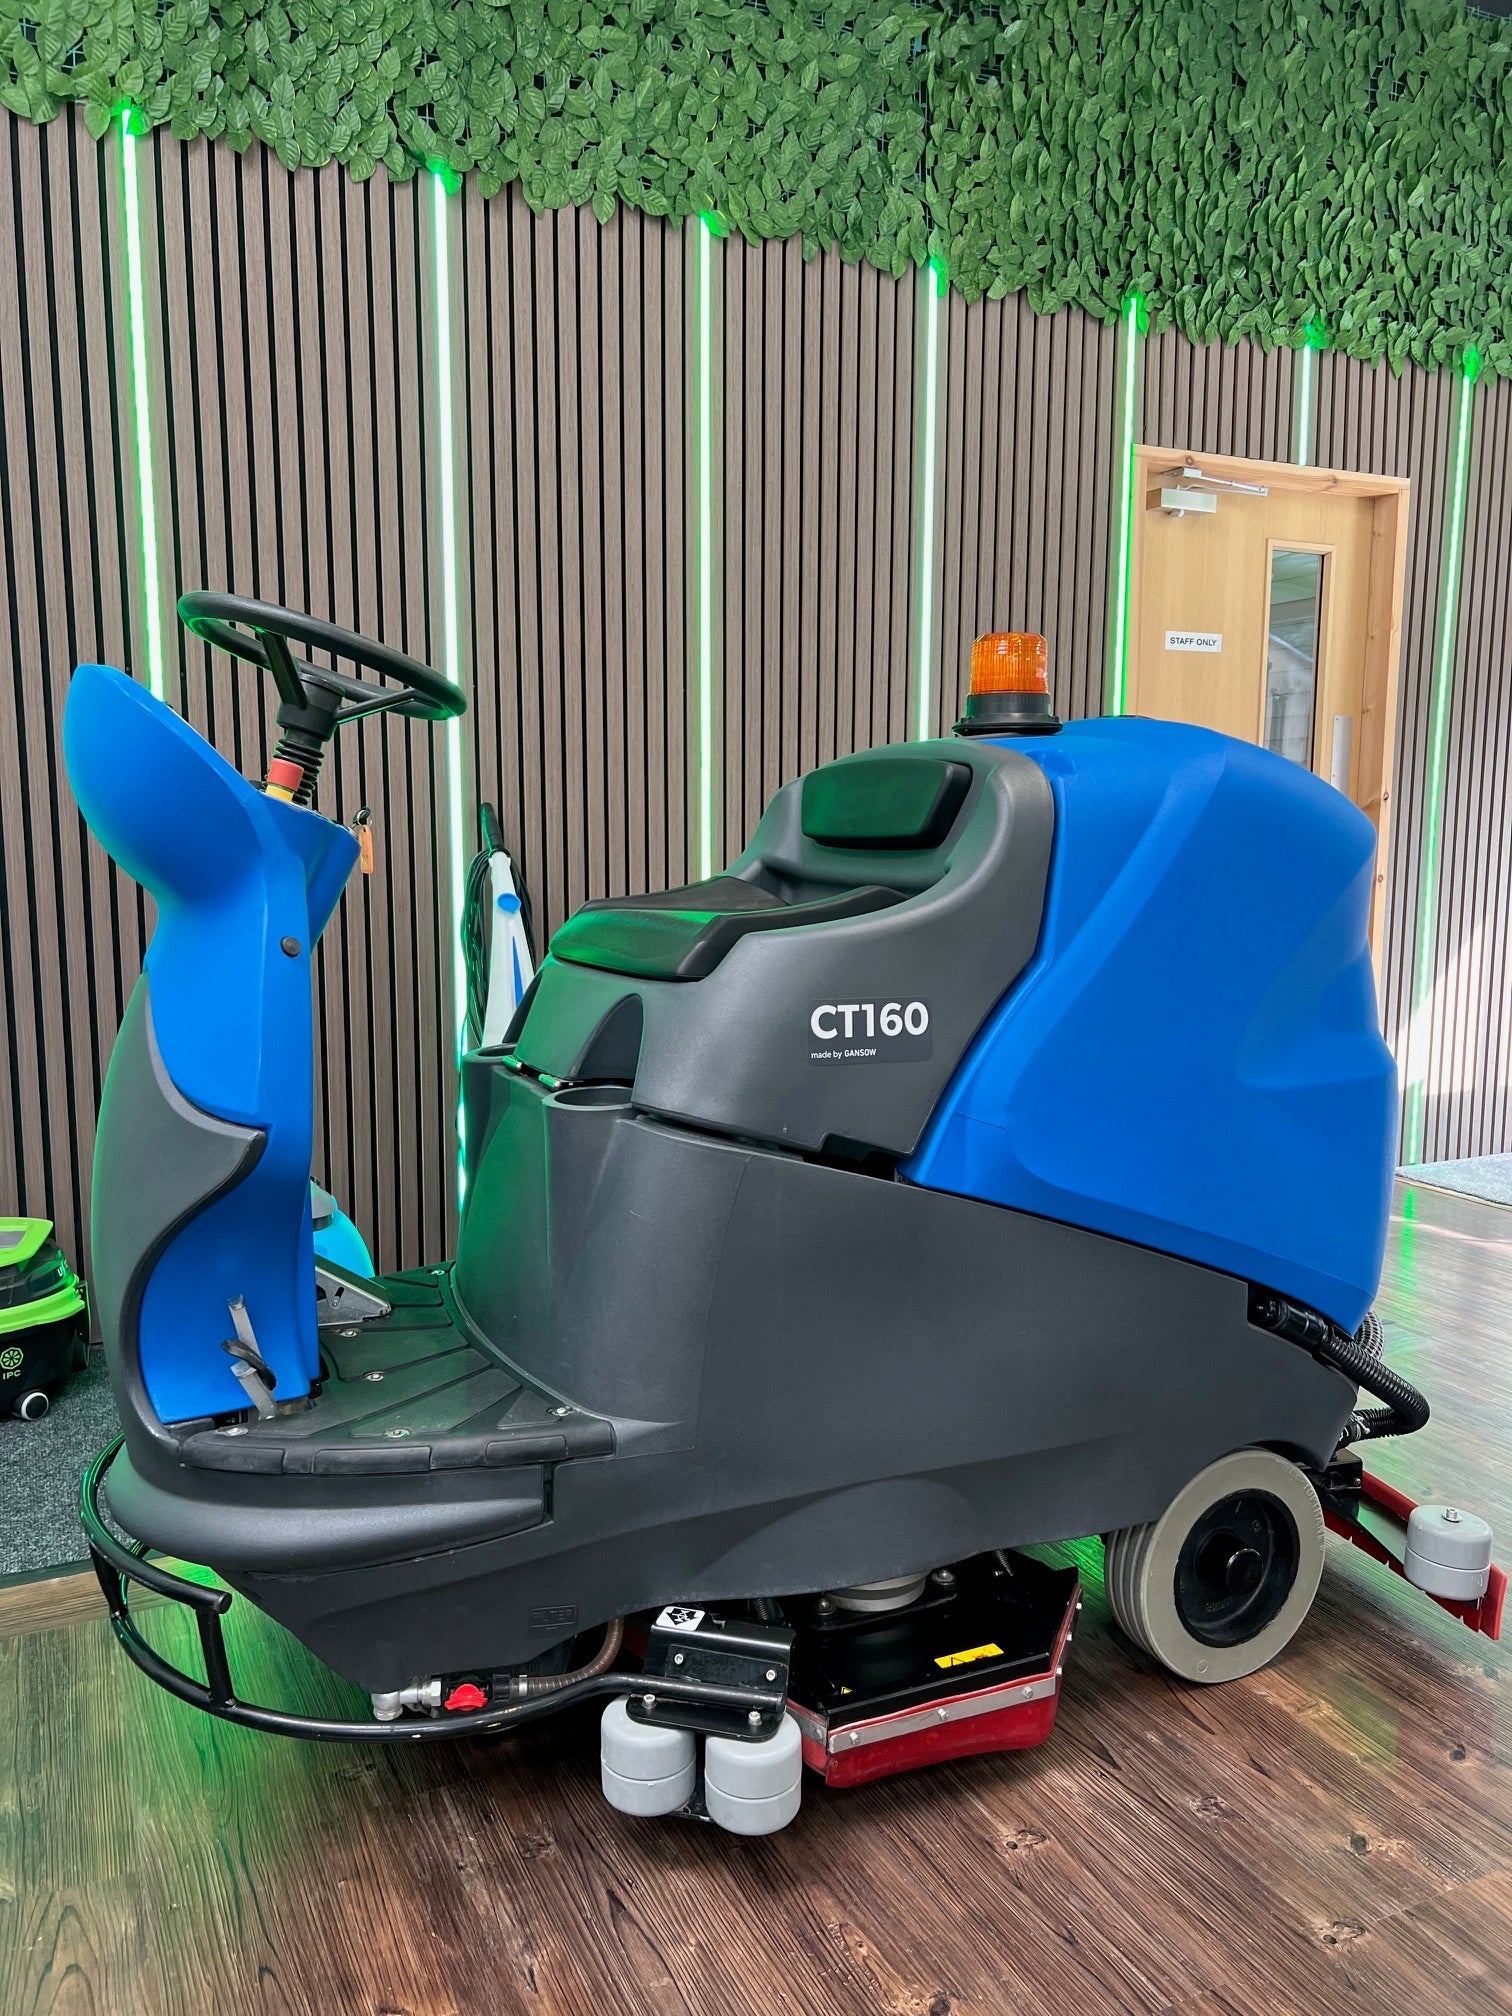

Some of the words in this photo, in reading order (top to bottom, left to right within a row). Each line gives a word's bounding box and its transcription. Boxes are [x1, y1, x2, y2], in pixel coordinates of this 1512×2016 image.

[1170, 636, 1194, 645] STAFF
[1196, 638, 1217, 646] ONLY
[810, 1001, 929, 1040] CT160
[810, 1050, 832, 1059] made
[833, 1050, 842, 1060] by
[844, 1048, 877, 1058] GANSOW
[2, 1369, 21, 1380] IPC
